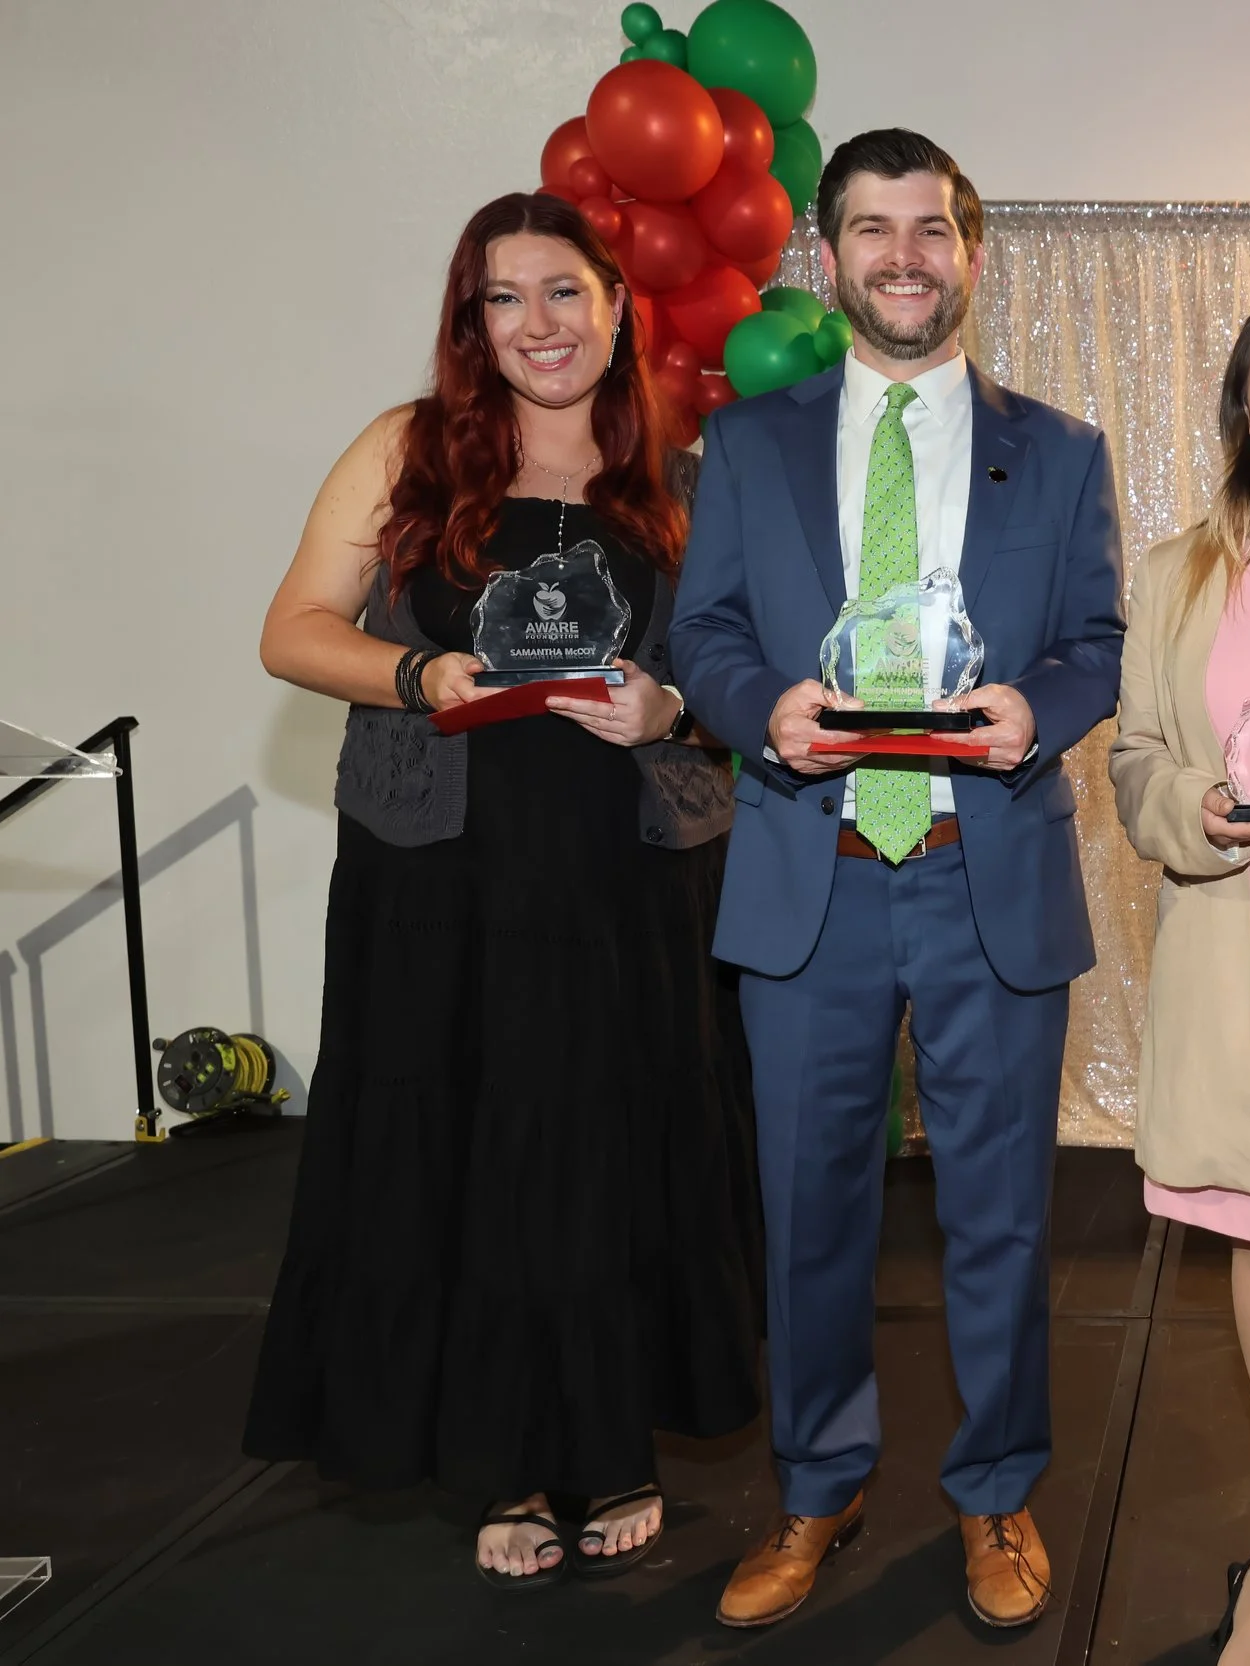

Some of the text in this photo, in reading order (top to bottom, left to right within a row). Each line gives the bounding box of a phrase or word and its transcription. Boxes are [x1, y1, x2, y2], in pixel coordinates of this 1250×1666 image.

[525, 622, 579, 633] AWARE
[510, 646, 597, 656] SAMANTHA McCOY
